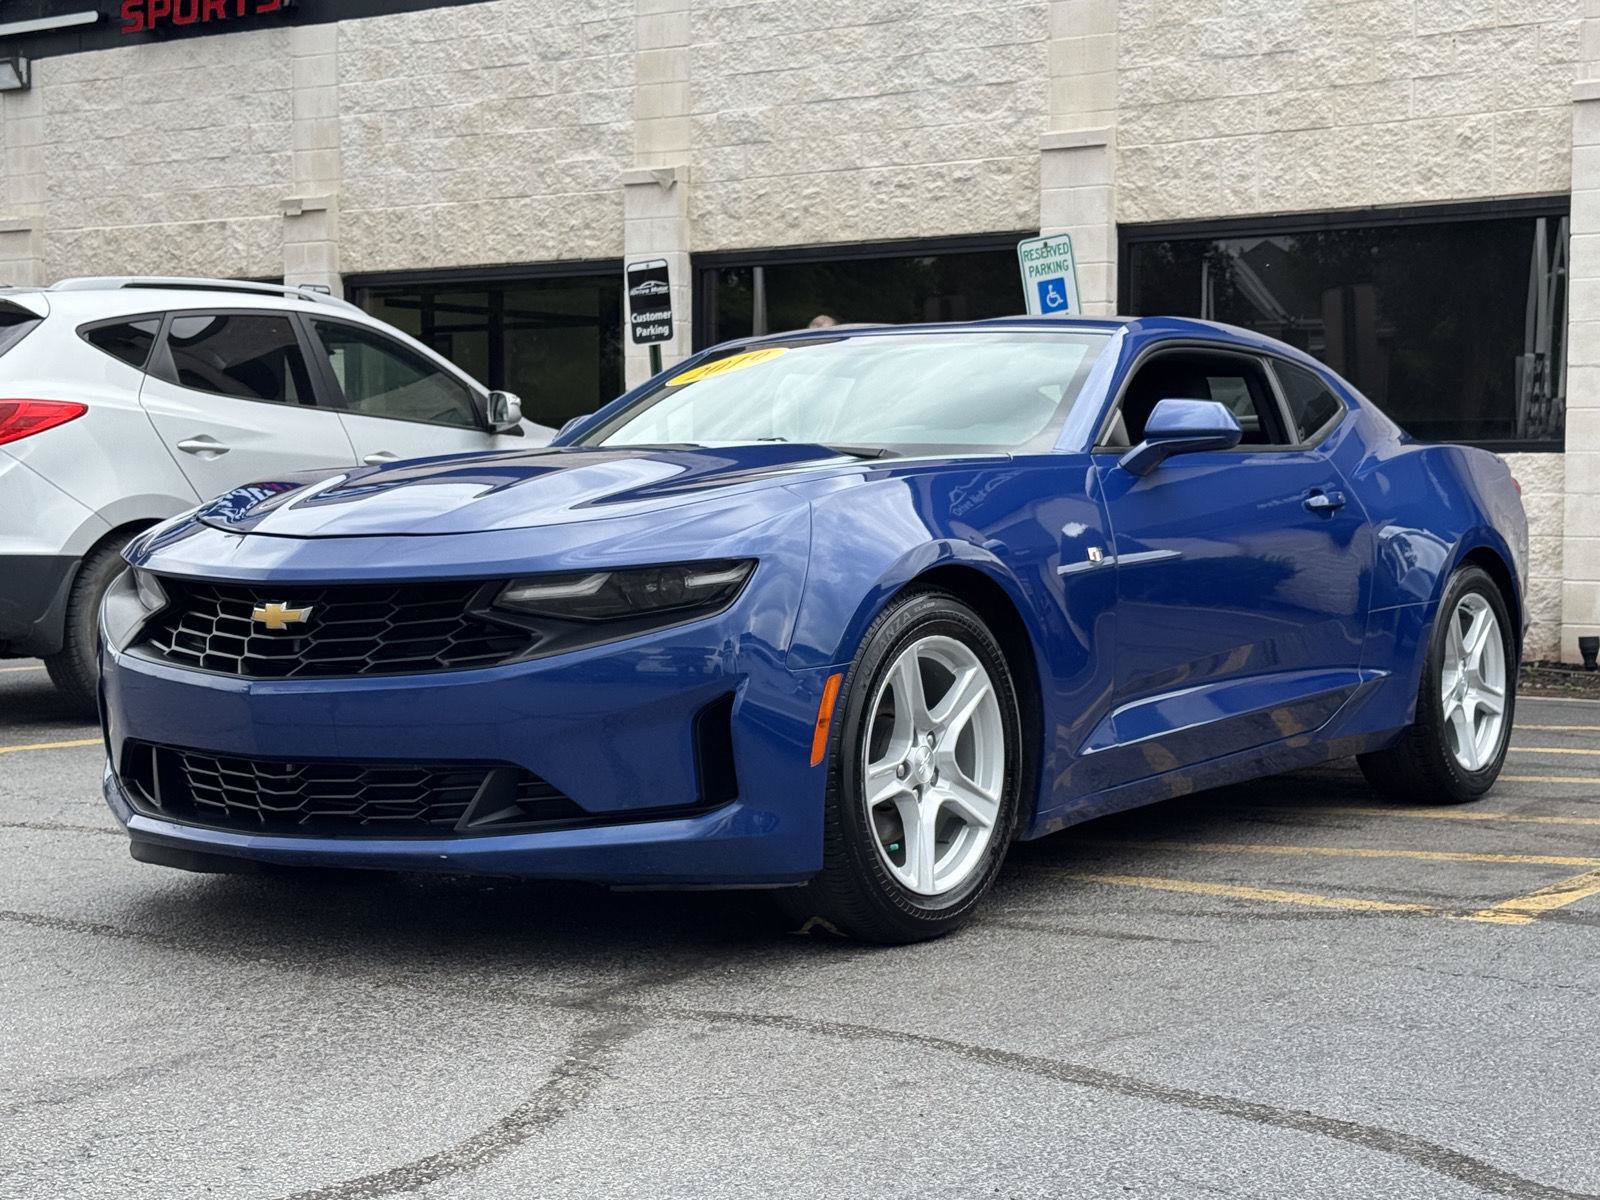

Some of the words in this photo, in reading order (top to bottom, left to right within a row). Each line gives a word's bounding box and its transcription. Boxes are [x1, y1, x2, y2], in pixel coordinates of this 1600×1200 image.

[1023, 242, 1069, 262] RESERVED
[1028, 260, 1069, 277] PARKING
[631, 311, 672, 323] Customer
[635, 324, 670, 337] Parking
